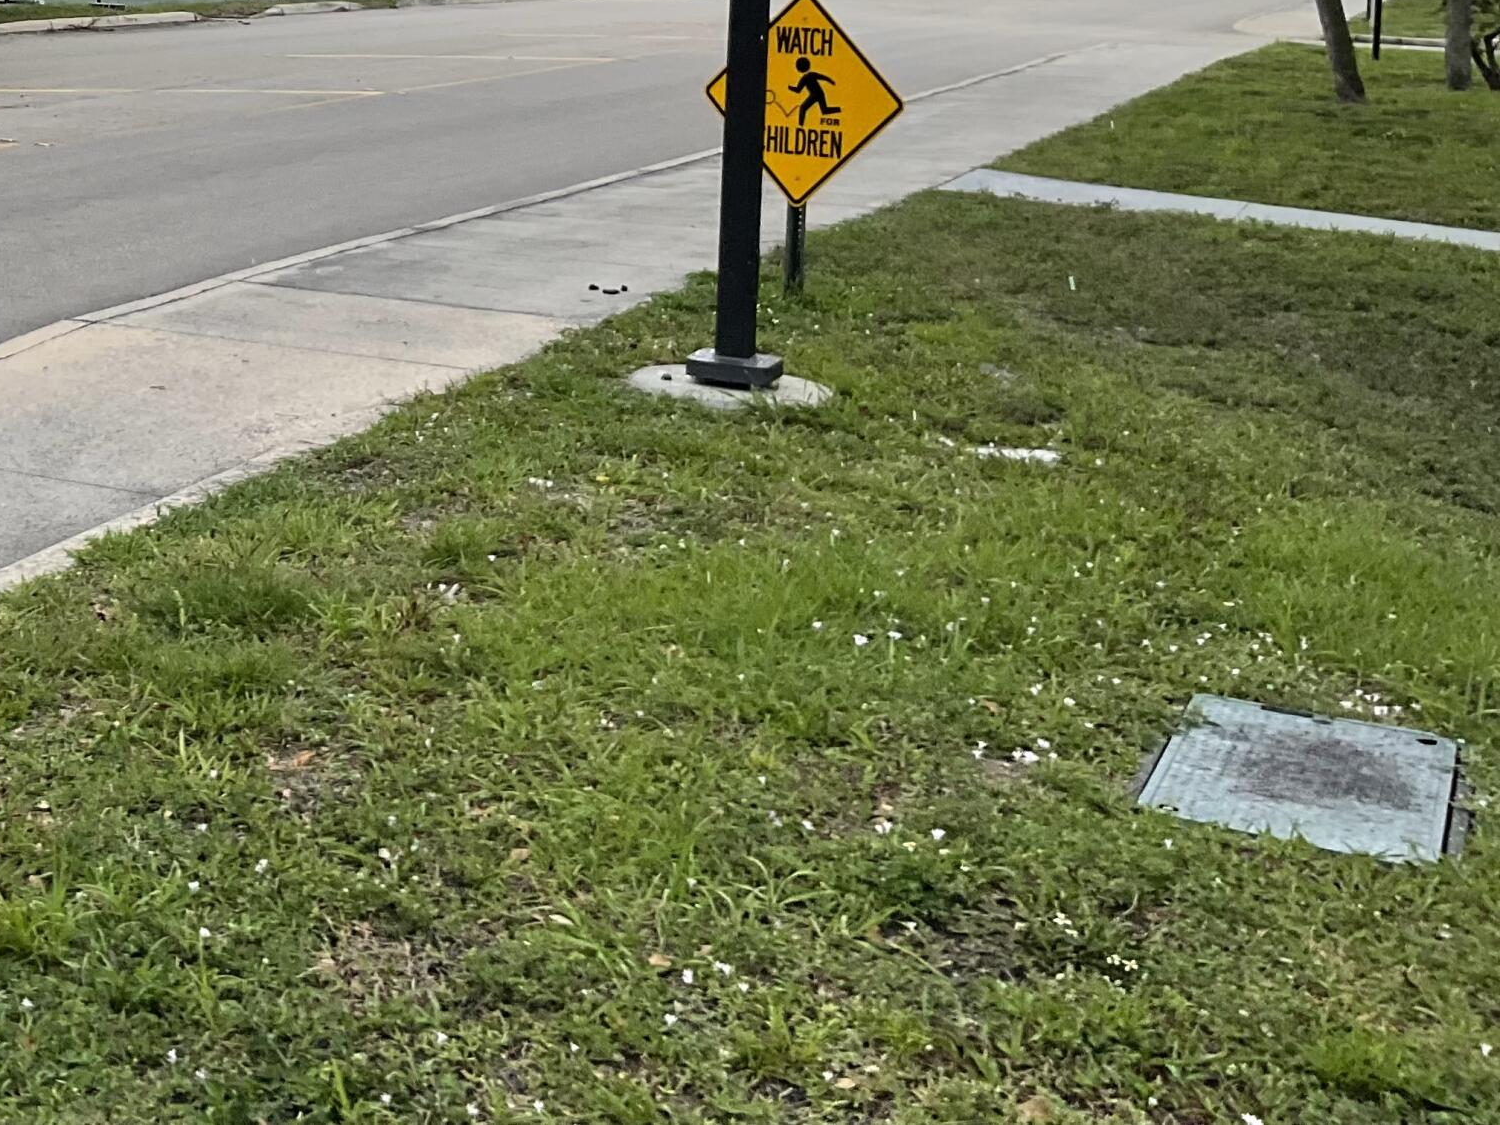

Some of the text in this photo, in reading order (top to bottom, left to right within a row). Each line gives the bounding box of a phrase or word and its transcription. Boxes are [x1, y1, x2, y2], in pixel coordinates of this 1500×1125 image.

[776, 26, 833, 56] WATCH
[820, 117, 840, 126] FOR
[763, 125, 842, 159] HILDREN
